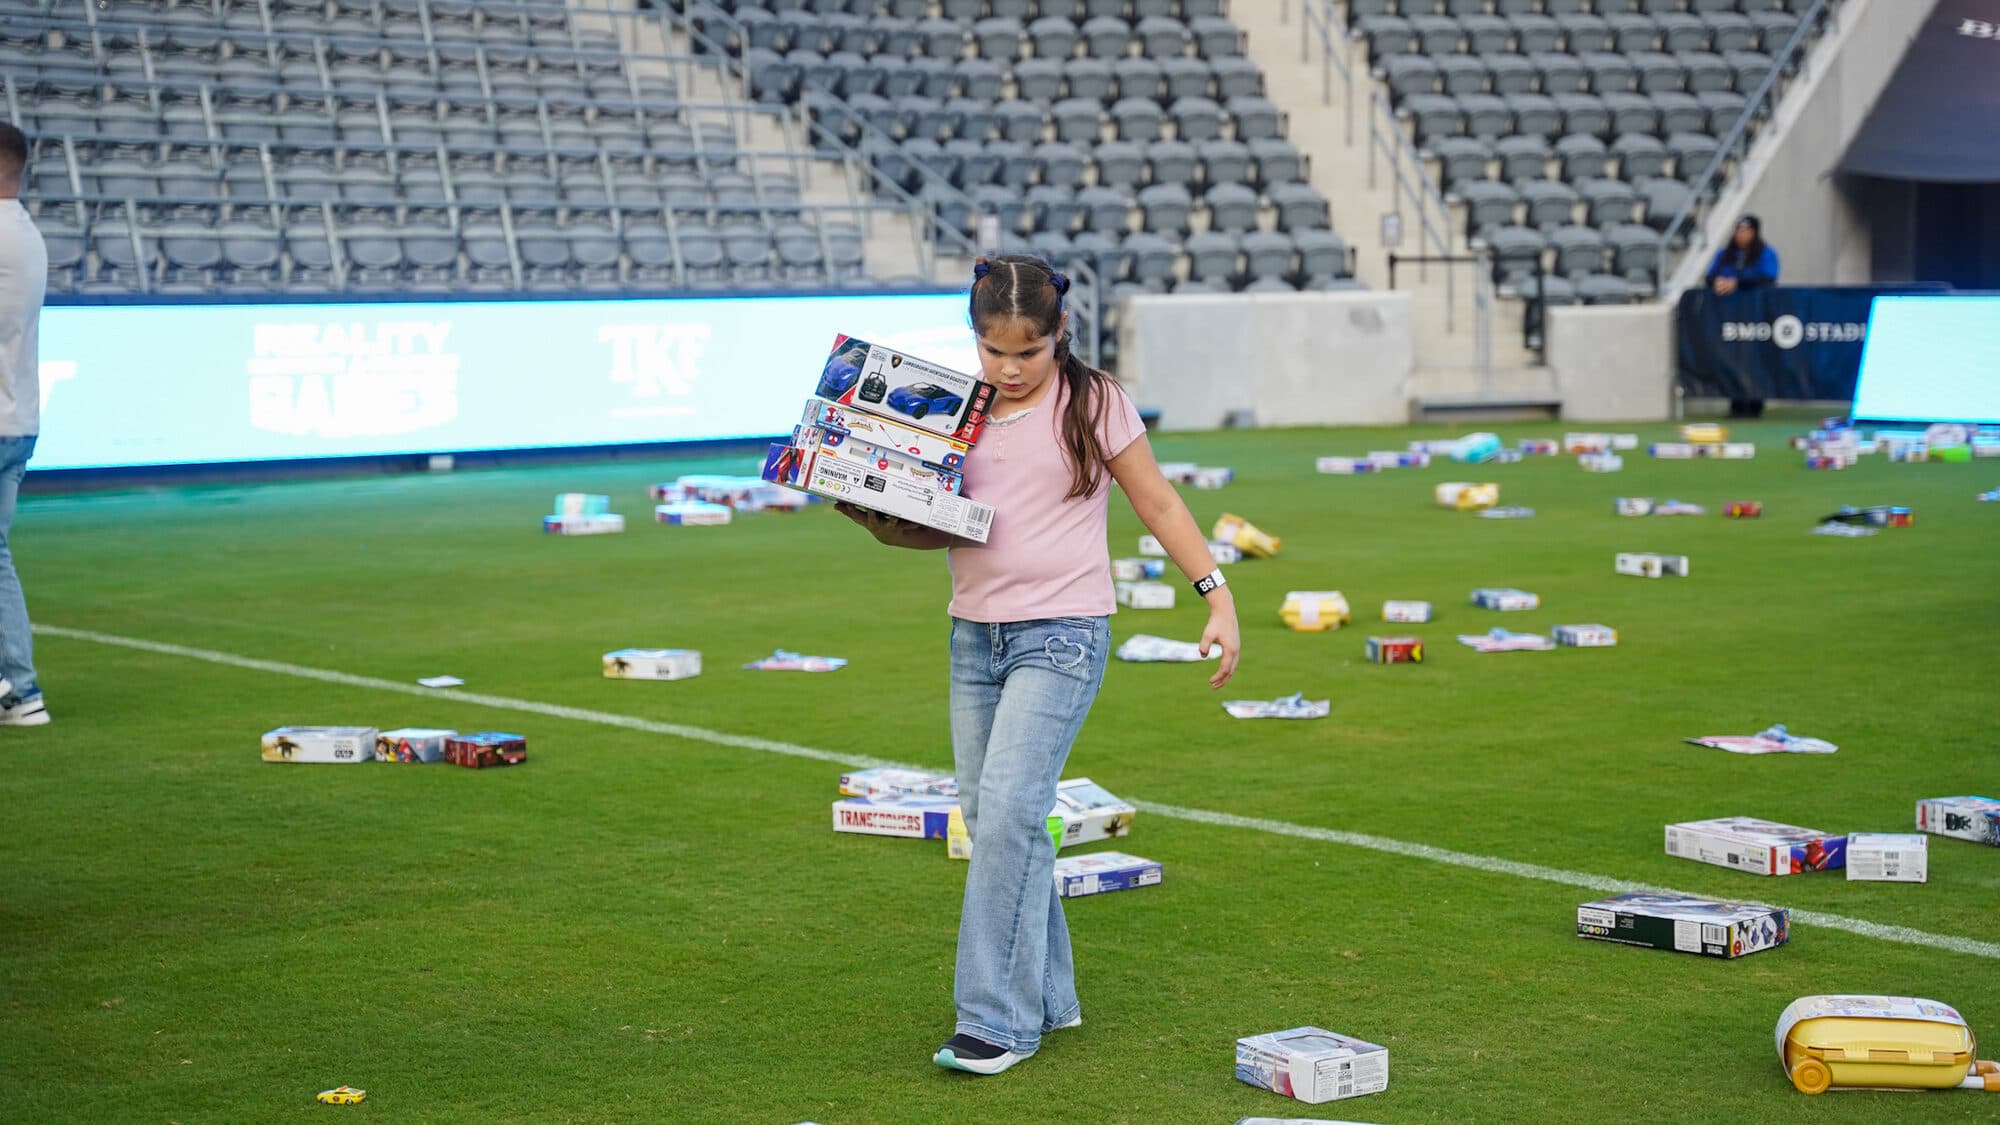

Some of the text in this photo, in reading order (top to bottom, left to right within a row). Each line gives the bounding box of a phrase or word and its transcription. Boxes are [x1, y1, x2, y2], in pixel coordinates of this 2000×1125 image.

[1722, 322, 1771, 341] BMO
[1199, 577, 1215, 592] SB
[839, 810, 921, 831] TRANSFORMERS
